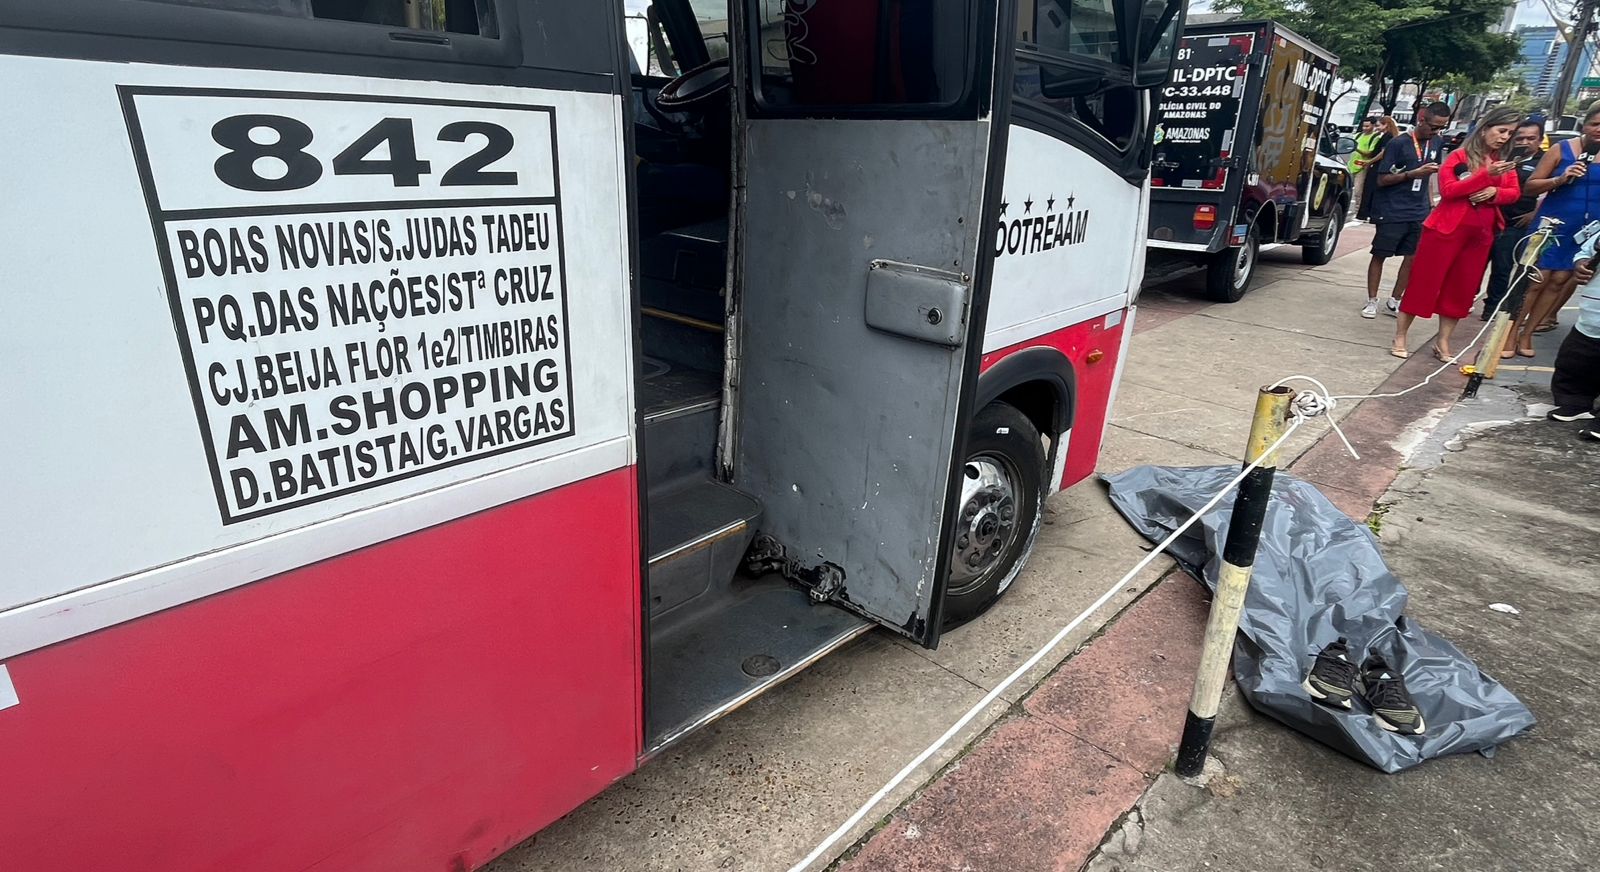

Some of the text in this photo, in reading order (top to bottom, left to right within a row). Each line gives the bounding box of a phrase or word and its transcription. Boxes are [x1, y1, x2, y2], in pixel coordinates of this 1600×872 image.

[1186, 102, 1207, 110] CIVIL
[1209, 102, 1221, 110] DO
[1292, 59, 1331, 96] IML-DPTC
[211, 114, 518, 192] 842
[1165, 127, 1210, 140] AMAZONAS
[178, 212, 550, 279] BOAS NOVAS/S.JUDAS TADEU
[192, 264, 554, 344] PQ.DAS NAÇÕES/STª CRUZ
[208, 315, 559, 407] CJ.BEIJA FLOR 1e2/TIMBIRAS
[226, 358, 560, 459] AM.SHOPPING
[230, 398, 566, 511] D.BATISTA/G.VARGAS
